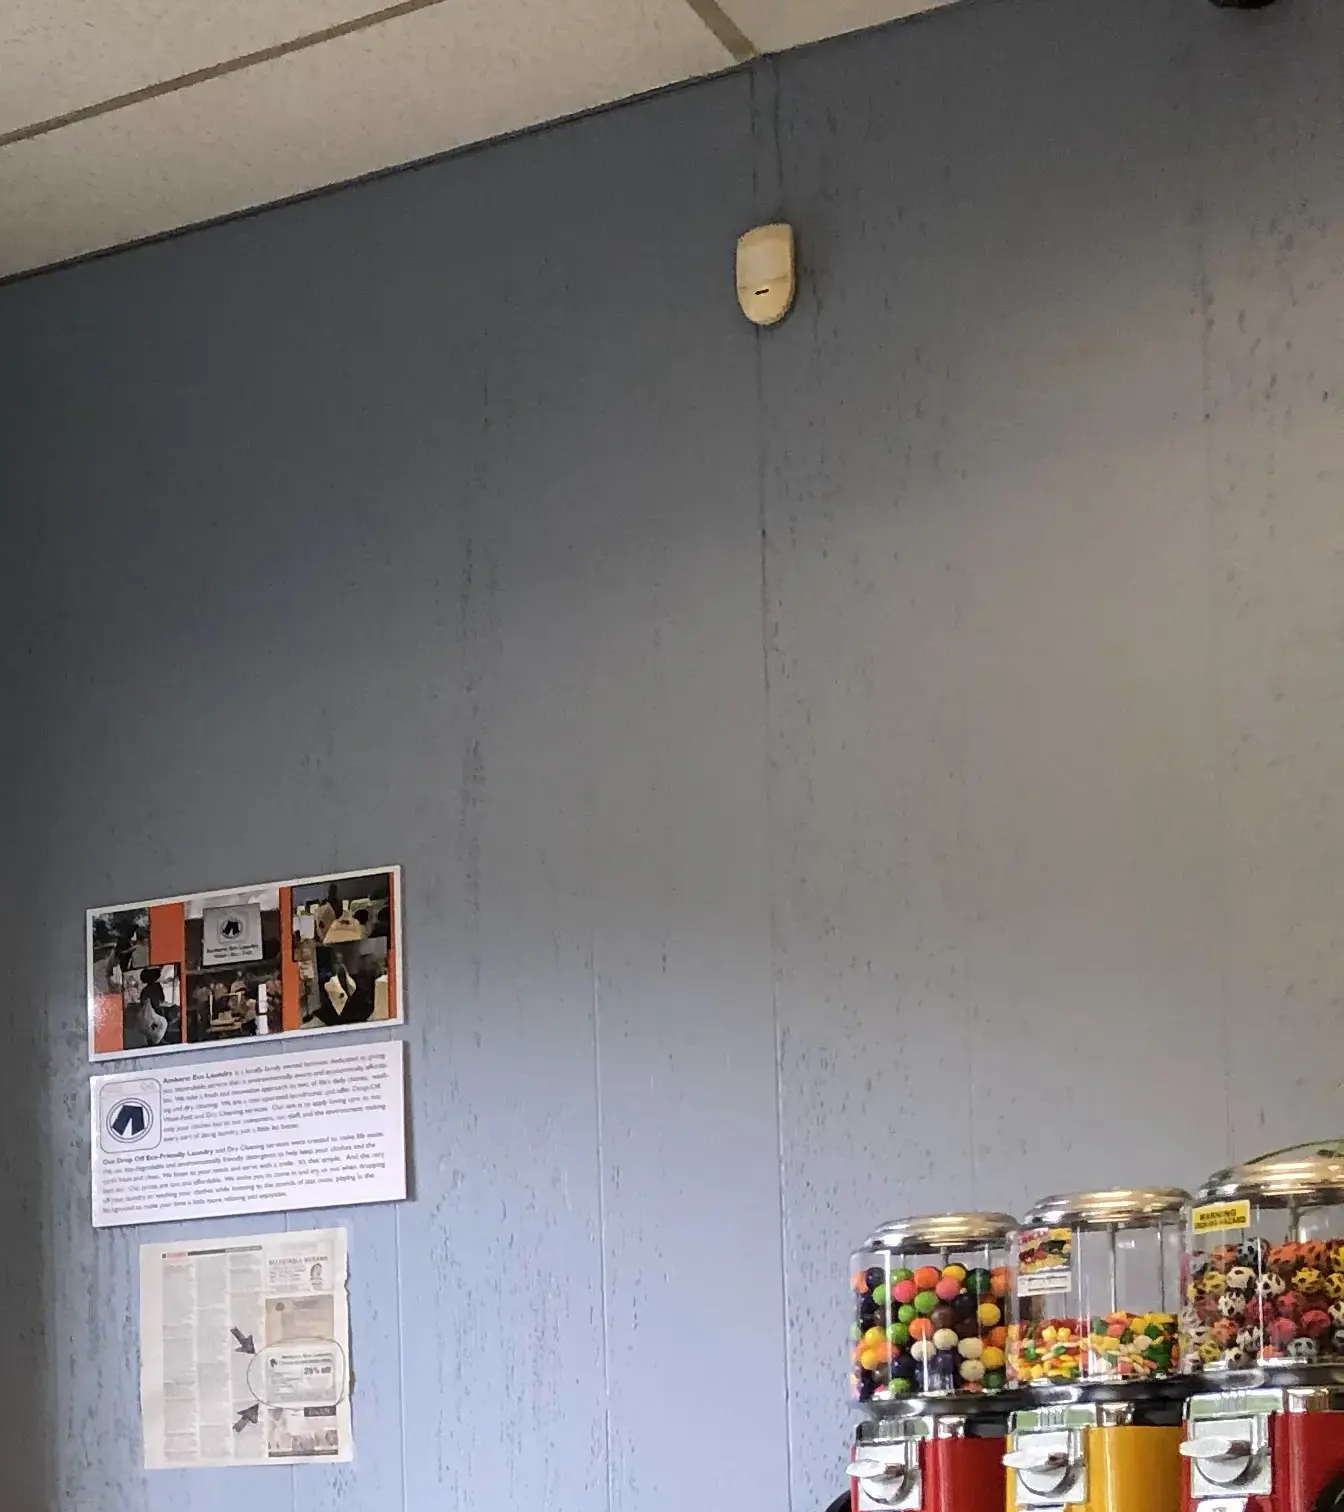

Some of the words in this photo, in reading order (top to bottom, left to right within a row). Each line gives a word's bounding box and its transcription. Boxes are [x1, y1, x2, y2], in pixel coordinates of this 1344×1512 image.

[163, 1075, 191, 1083] Amherst
[193, 1073, 205, 1081] Eco
[206, 1069, 233, 1081] Laundry
[117, 1155, 132, 1166] Drop
[135, 1155, 145, 1163] Off
[146, 1150, 185, 1162] Eco-Friendly
[187, 1147, 214, 1158] Laundry
[240, 1141, 265, 1152] Cleaning
[1200, 1209, 1237, 1222] WARNING
[1219, 1217, 1246, 1227] HAZARD
